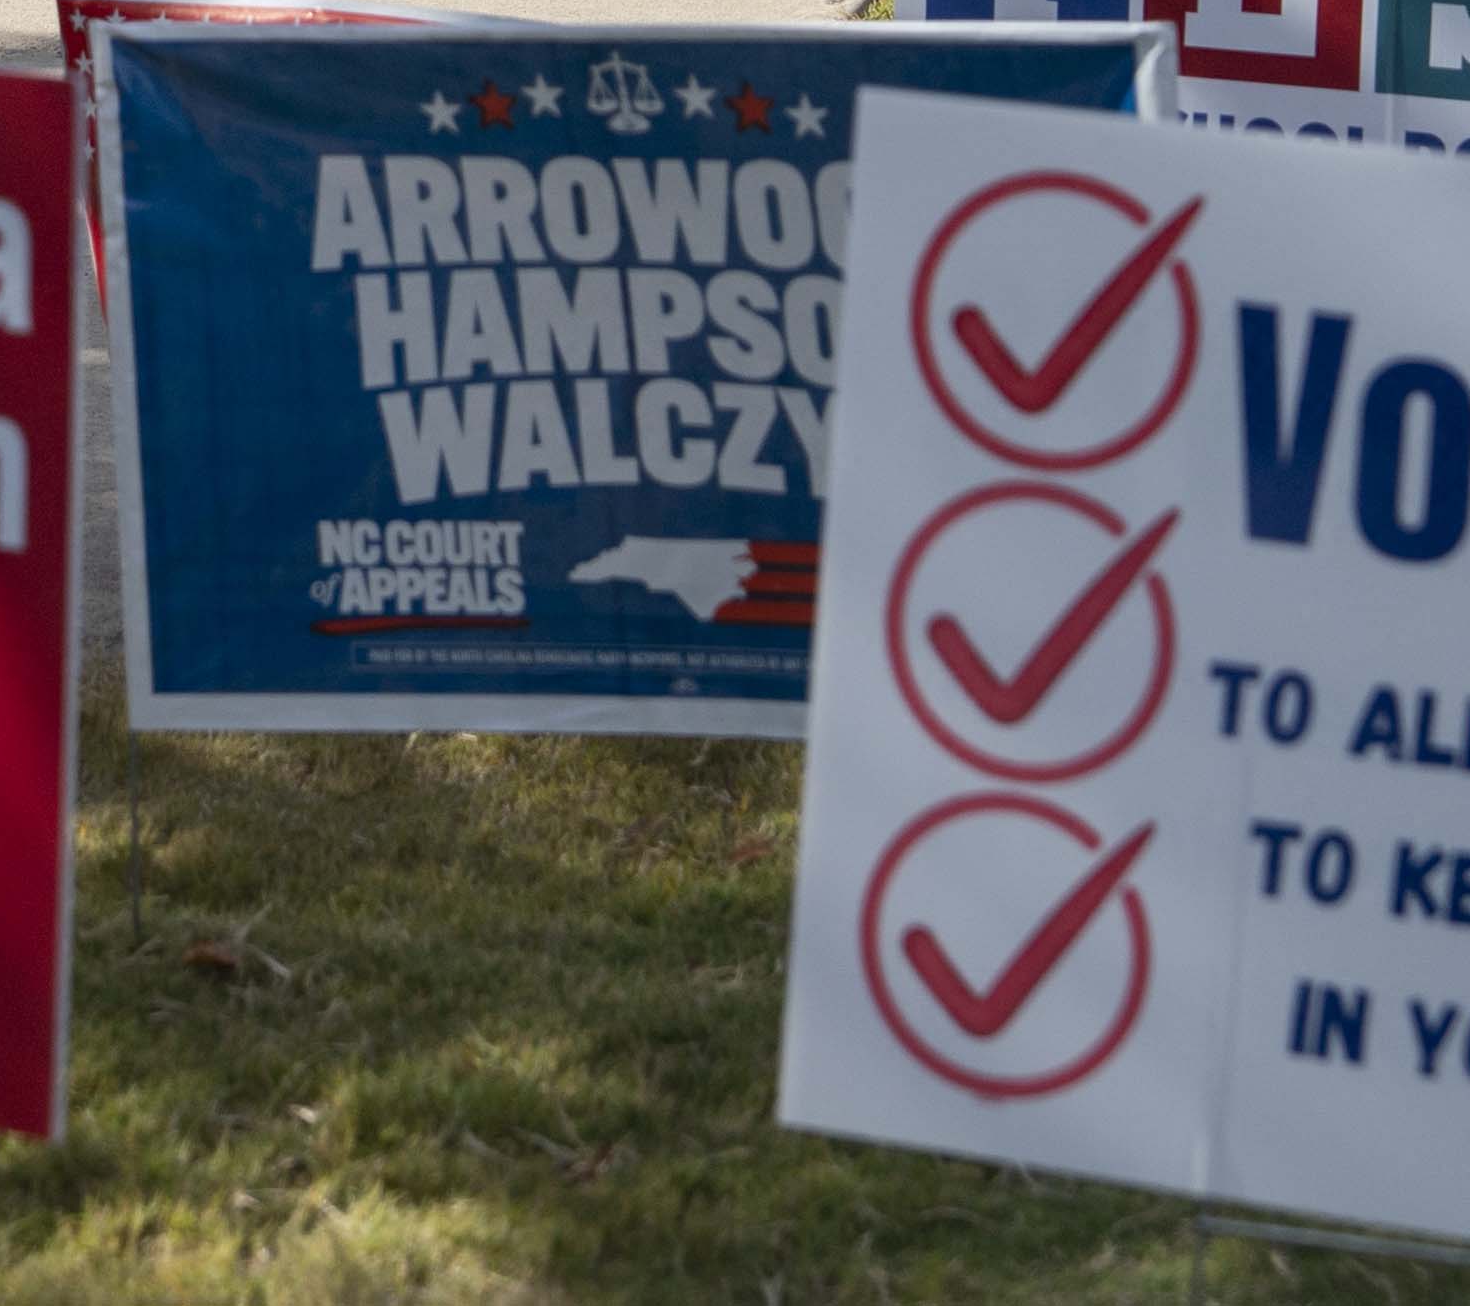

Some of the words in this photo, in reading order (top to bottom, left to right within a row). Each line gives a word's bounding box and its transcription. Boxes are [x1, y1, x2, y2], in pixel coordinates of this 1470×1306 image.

[318, 521, 388, 569] NC
[389, 519, 525, 568] COURT
[310, 576, 340, 610] of
[339, 568, 527, 618] APPEALS
[1208, 659, 1312, 747] TO
[1249, 818, 1357, 907] TO
[1289, 976, 1368, 1070] IN
